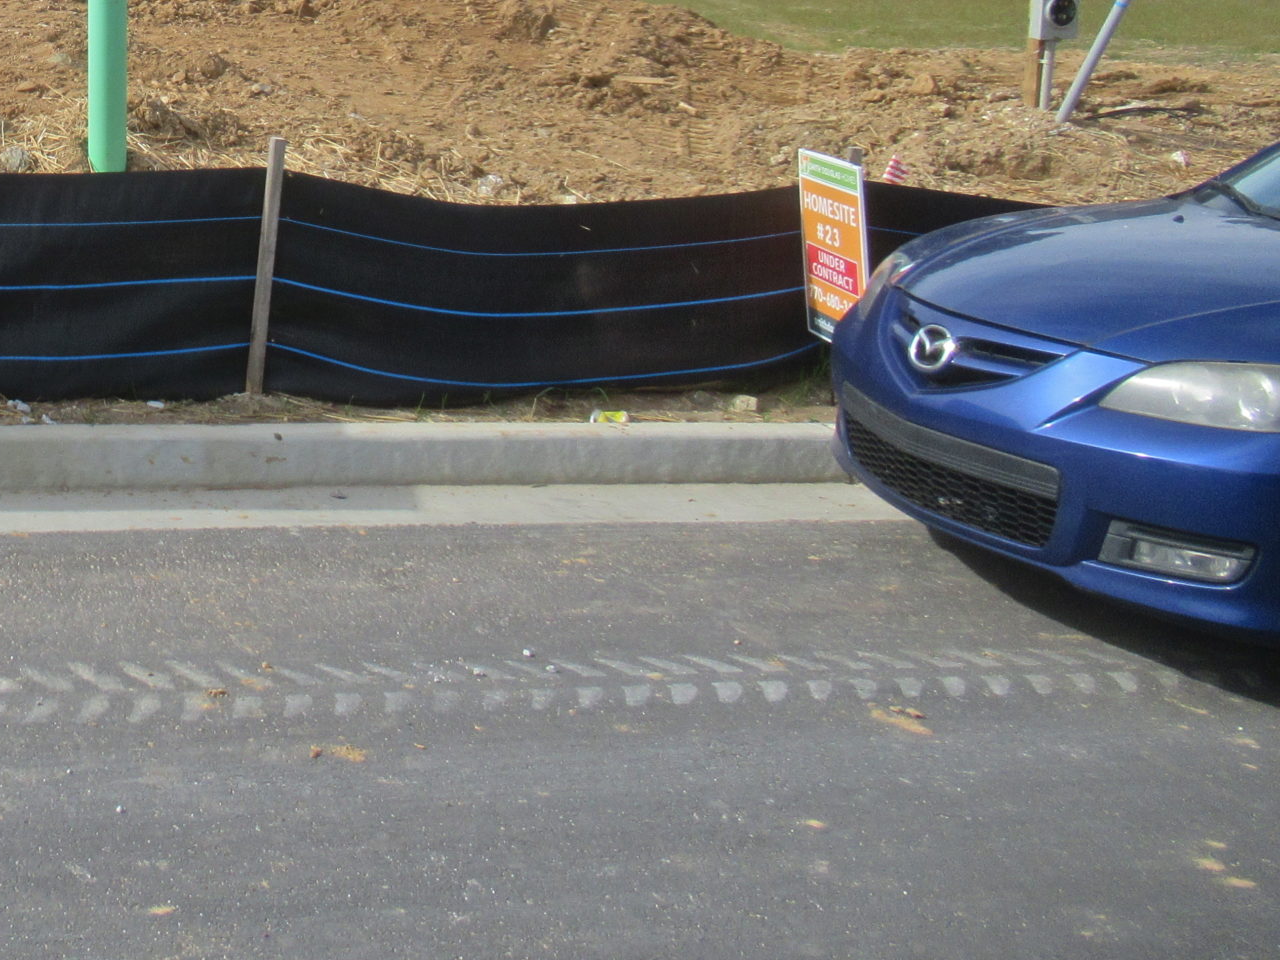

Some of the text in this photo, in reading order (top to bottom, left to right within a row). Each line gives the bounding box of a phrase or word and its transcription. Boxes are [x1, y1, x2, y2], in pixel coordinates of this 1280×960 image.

[804, 191, 857, 227] HOMESITE
[816, 223, 840, 247] #23
[818, 250, 845, 272] UNDER
[812, 262, 853, 291] CONTRACT
